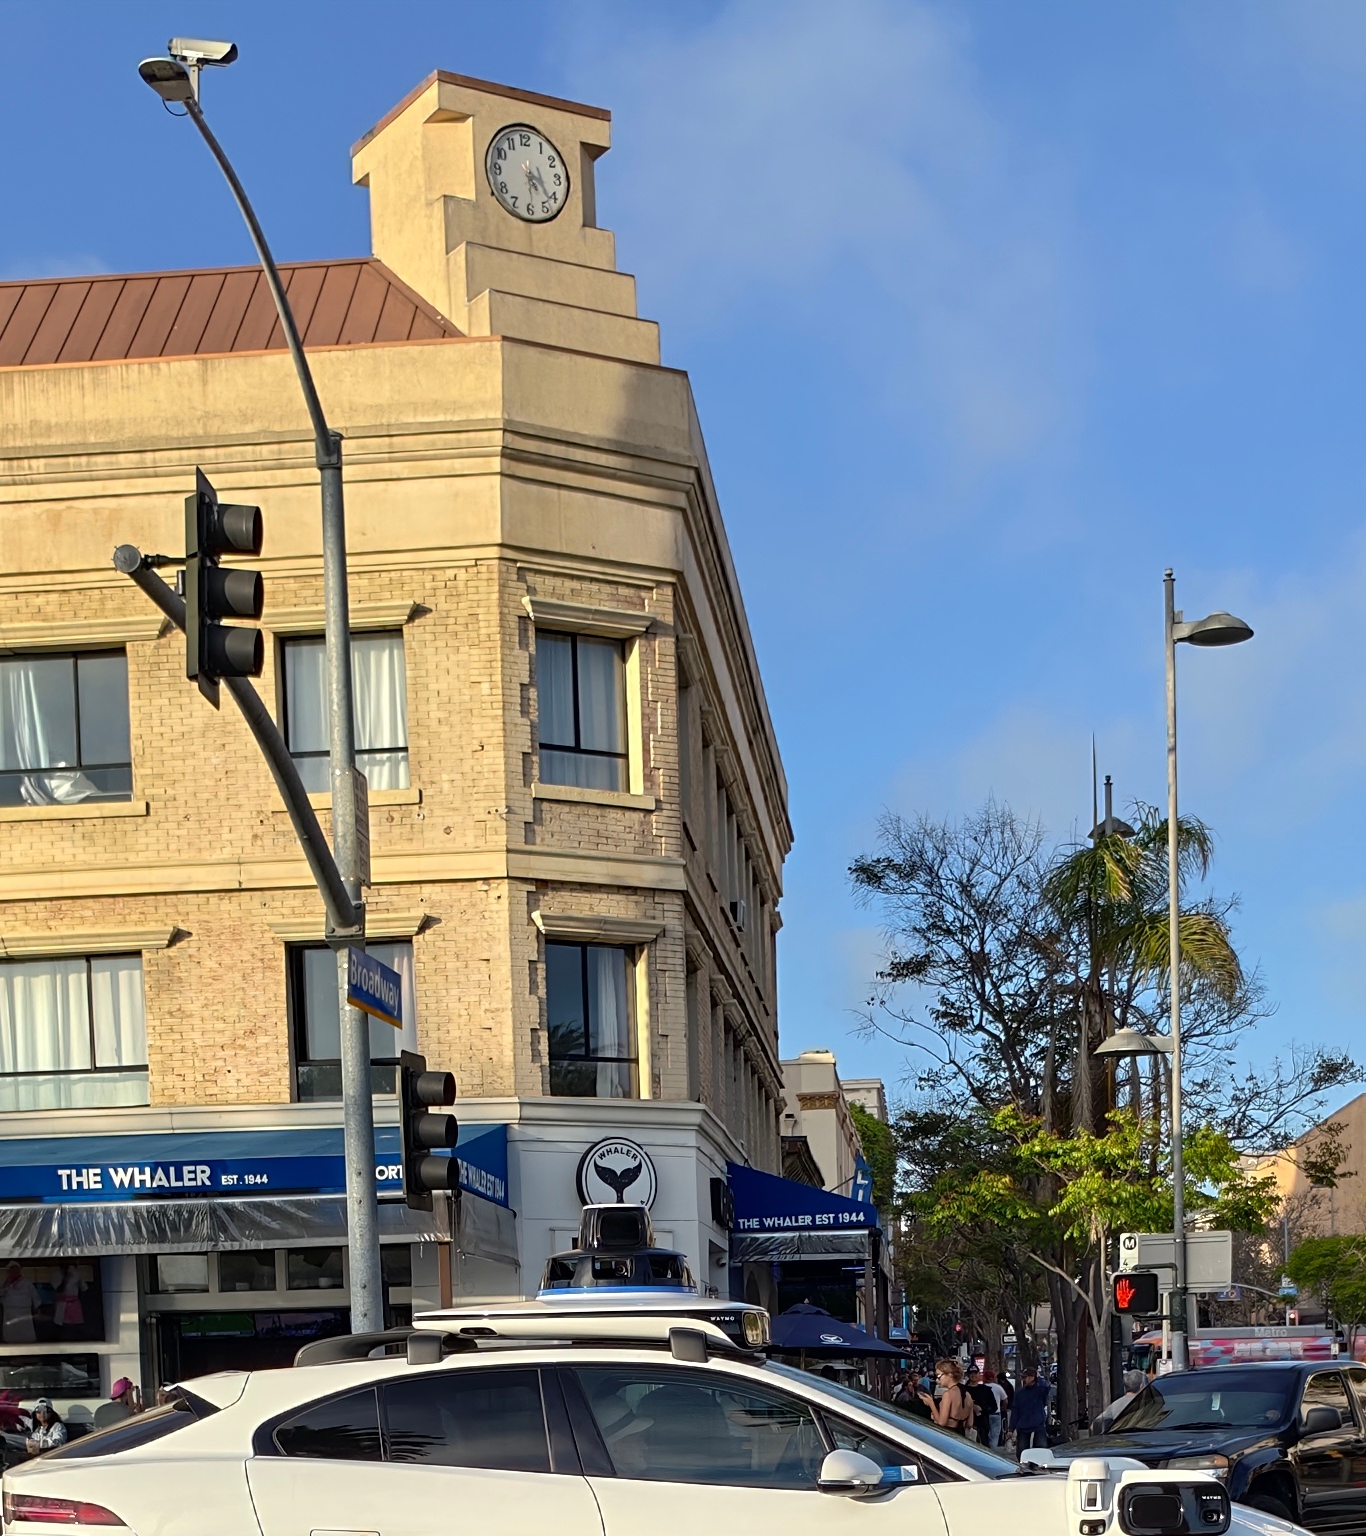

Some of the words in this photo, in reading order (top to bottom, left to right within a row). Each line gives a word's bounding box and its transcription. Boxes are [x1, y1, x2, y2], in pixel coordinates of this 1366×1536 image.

[506, 136, 515, 151] 11
[519, 133, 531, 147] 12
[496, 146, 507, 161] 10
[538, 141, 543, 155] 1
[547, 154, 556, 169] 2
[493, 162, 502, 176] 9
[553, 173, 562, 187] 3
[499, 181, 509, 195] 8
[510, 195, 519, 209] 7
[549, 191, 559, 204] 4
[526, 202, 535, 216] 6
[541, 201, 550, 214] 5
[350, 953, 399, 1017] Broadway
[597, 1146, 639, 1162] WHALER
[57, 1169, 103, 1190] THE
[108, 1165, 212, 1189] WHALER
[244, 1174, 269, 1184] 1944
[375, 1165, 403, 1180] ORT
[738, 1218, 761, 1229] THE
[763, 1214, 812, 1228] WHALER
[815, 1213, 836, 1225] EST
[838, 1211, 865, 1223] 1944
[1254, 1327, 1288, 1338] Metro
